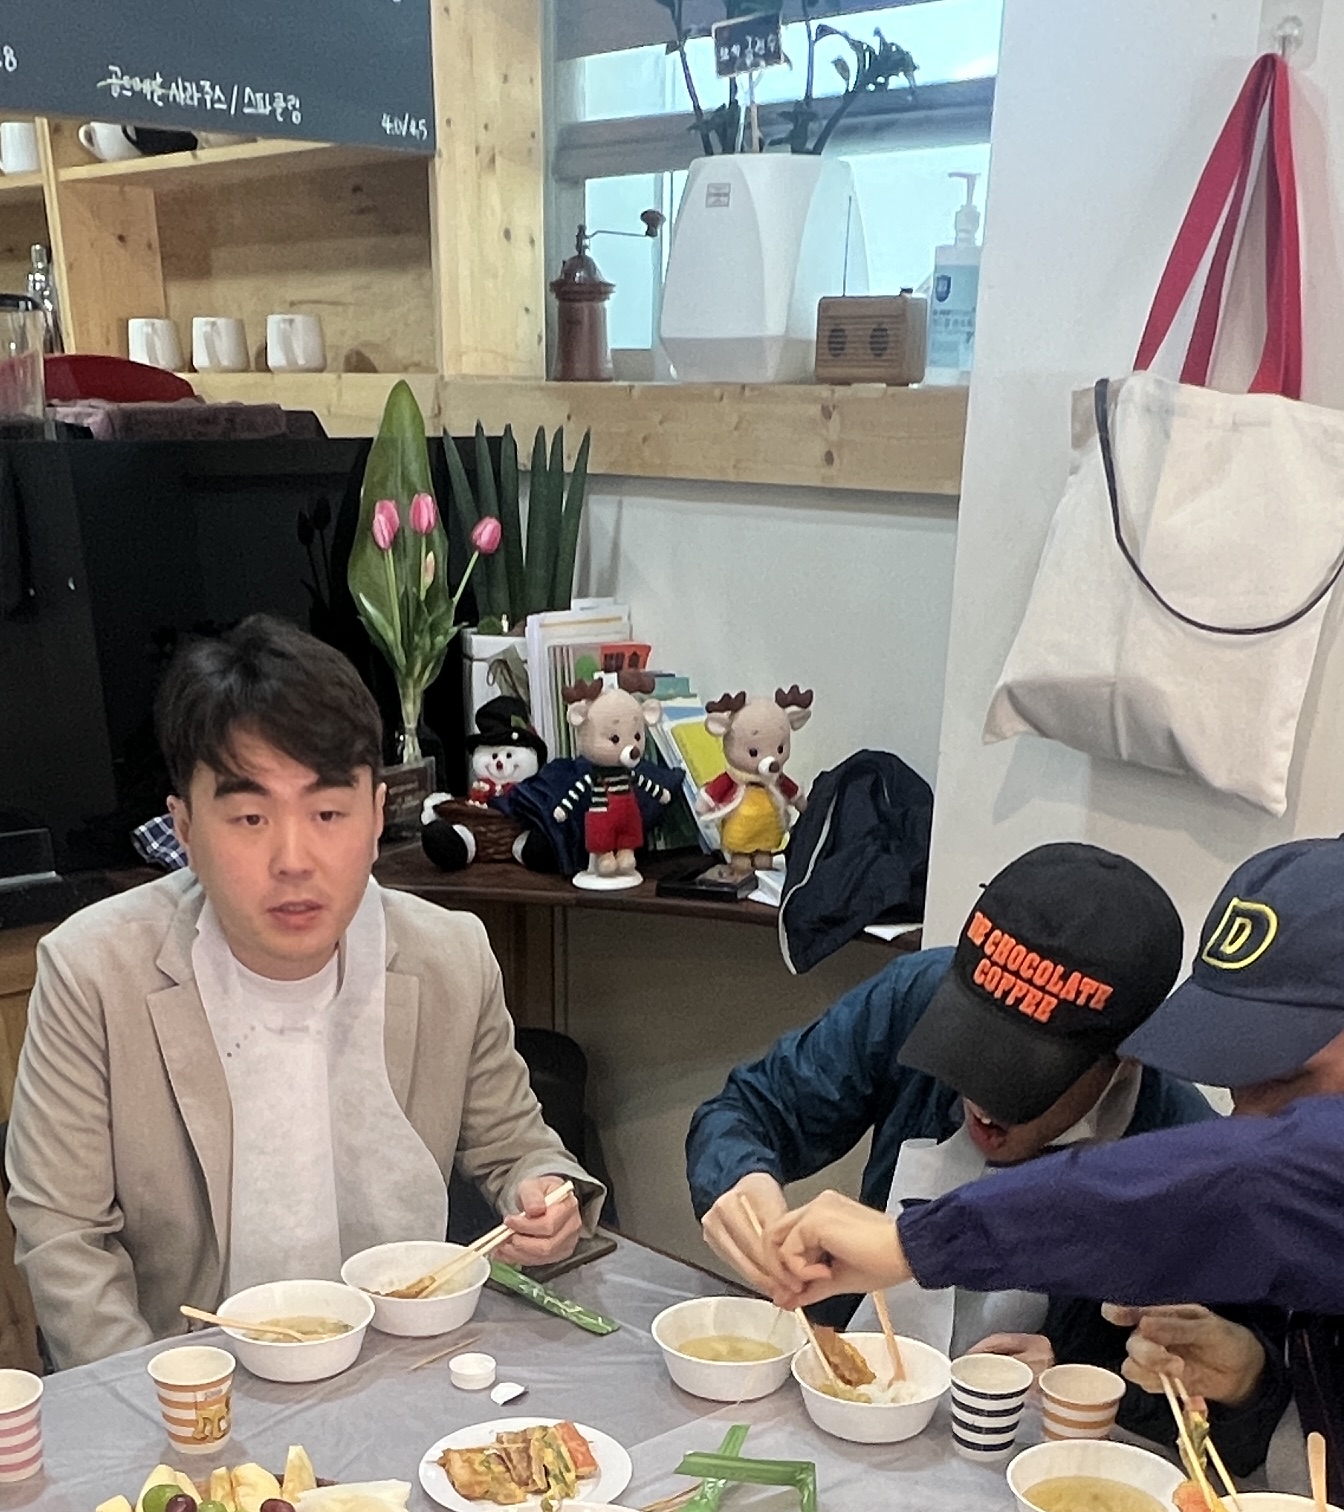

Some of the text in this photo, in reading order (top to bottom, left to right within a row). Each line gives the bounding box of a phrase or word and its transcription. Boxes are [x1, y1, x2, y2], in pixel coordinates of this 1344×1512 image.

[1201, 897, 1278, 970] D
[973, 958, 1059, 1024] COFFEE
[983, 929, 1114, 1012] CHOCOLATE
